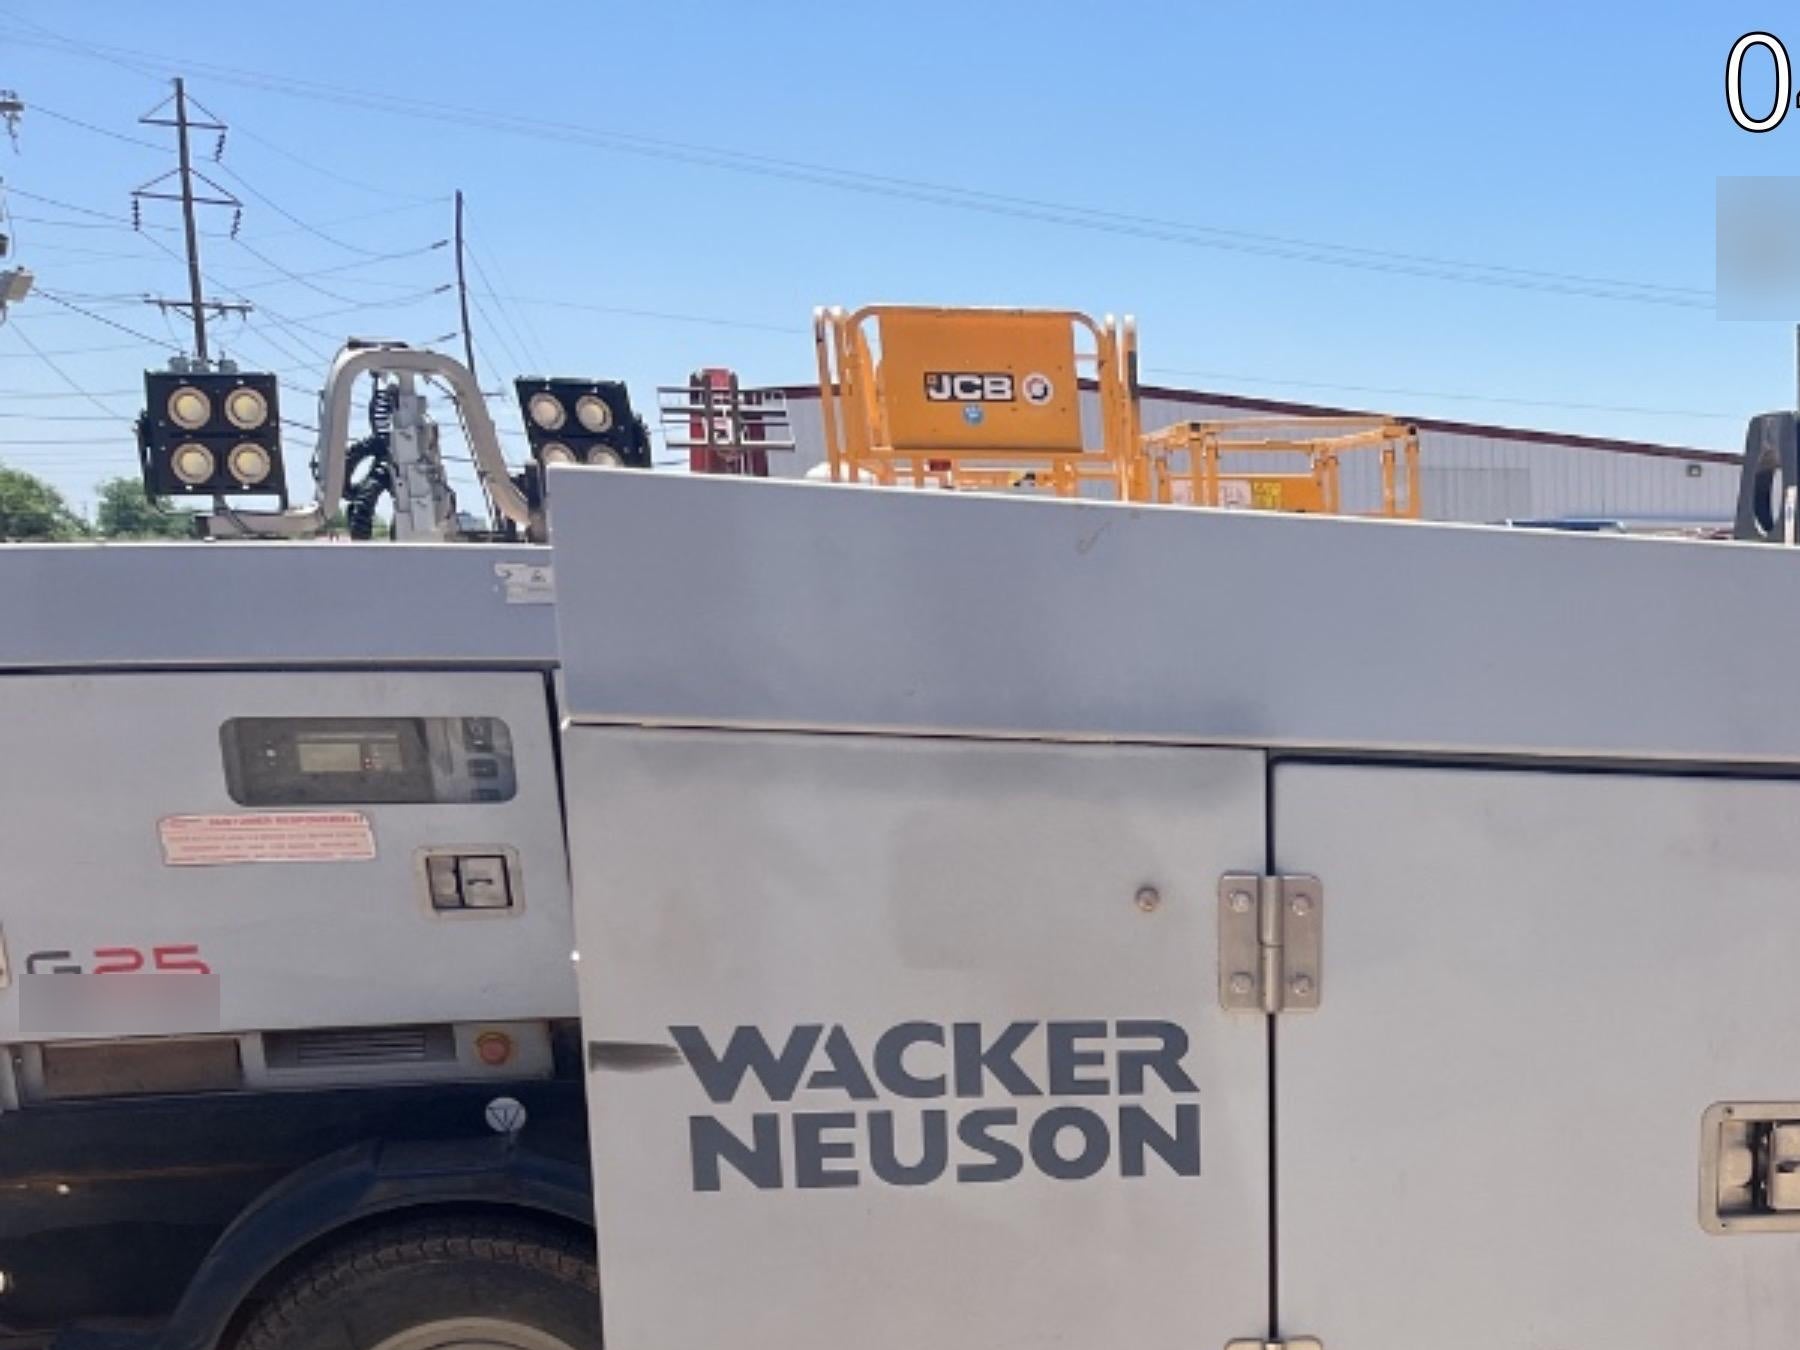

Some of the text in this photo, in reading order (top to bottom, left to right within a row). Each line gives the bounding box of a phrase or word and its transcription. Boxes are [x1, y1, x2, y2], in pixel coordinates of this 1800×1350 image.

[928, 374, 1013, 400] JCB
[668, 1020, 1201, 1103] WACKER
[689, 1104, 1201, 1192] NEUSON
